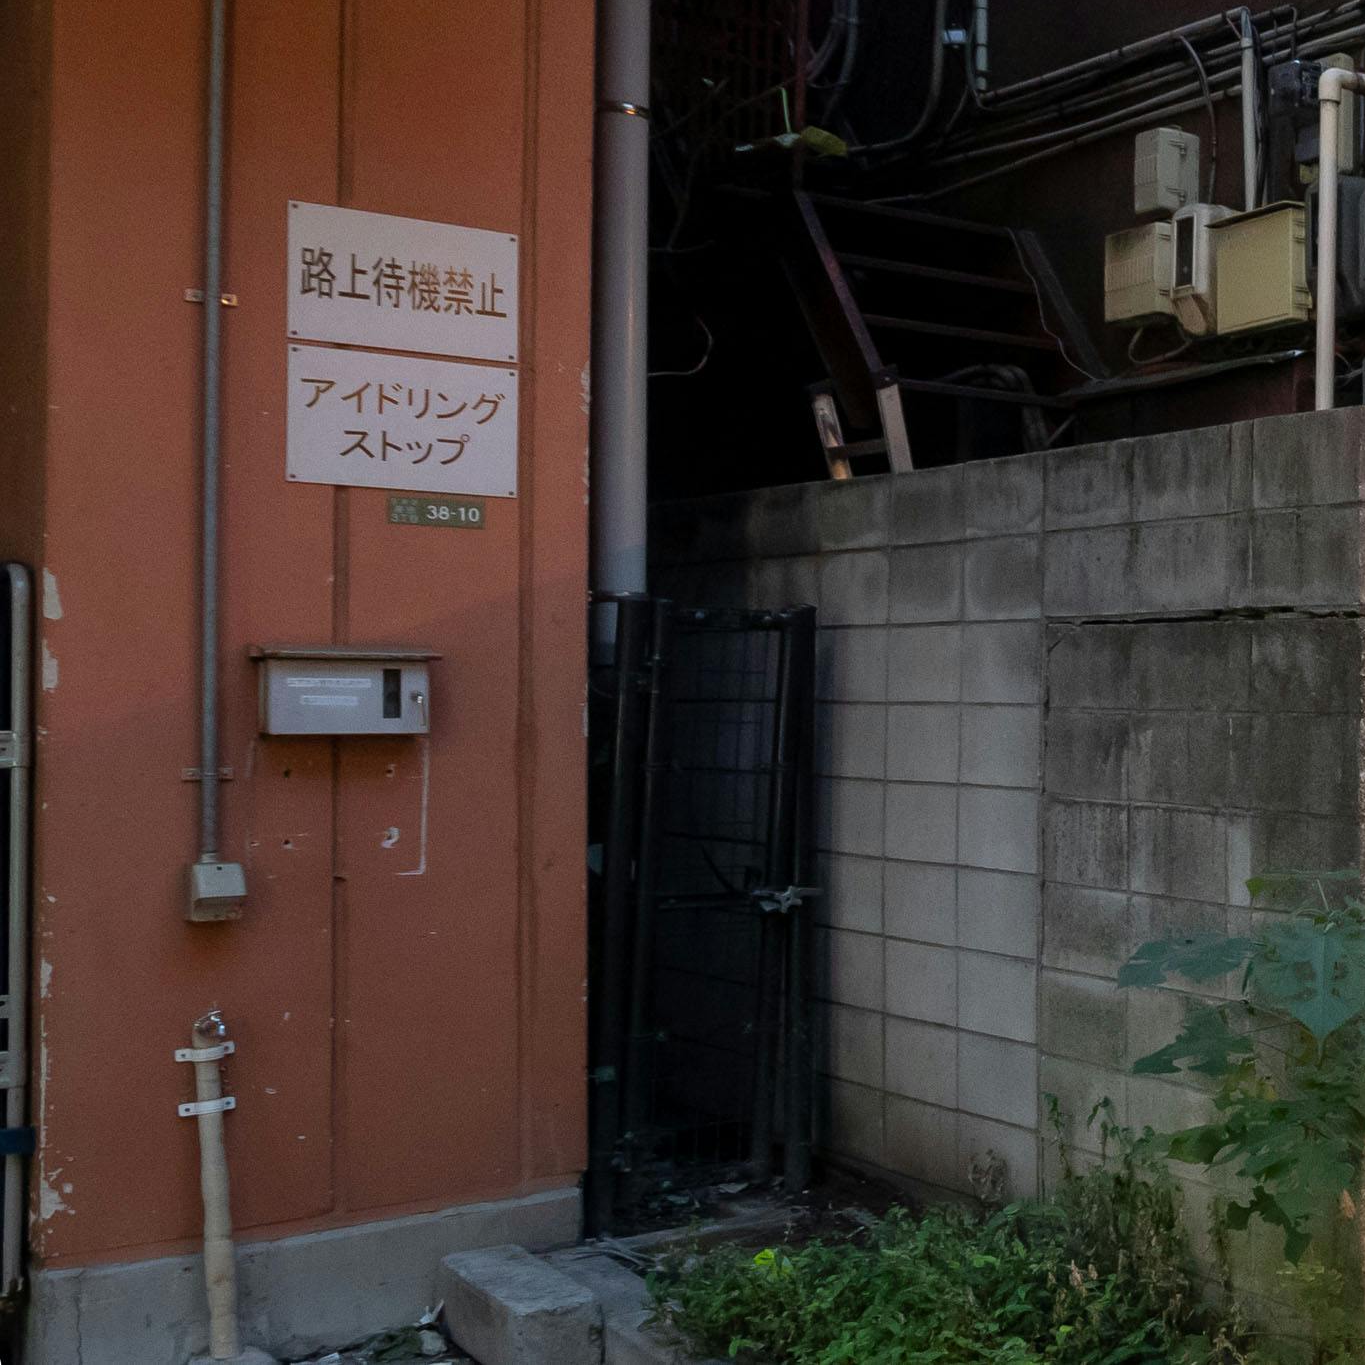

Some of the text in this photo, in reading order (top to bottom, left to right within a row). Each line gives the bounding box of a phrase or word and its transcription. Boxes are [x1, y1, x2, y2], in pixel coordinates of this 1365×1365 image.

[300, 246, 508, 319] 路上待機禁止
[300, 378, 506, 425] アイドリング
[339, 430, 471, 465] ストップ
[426, 505, 481, 523] 38-10
